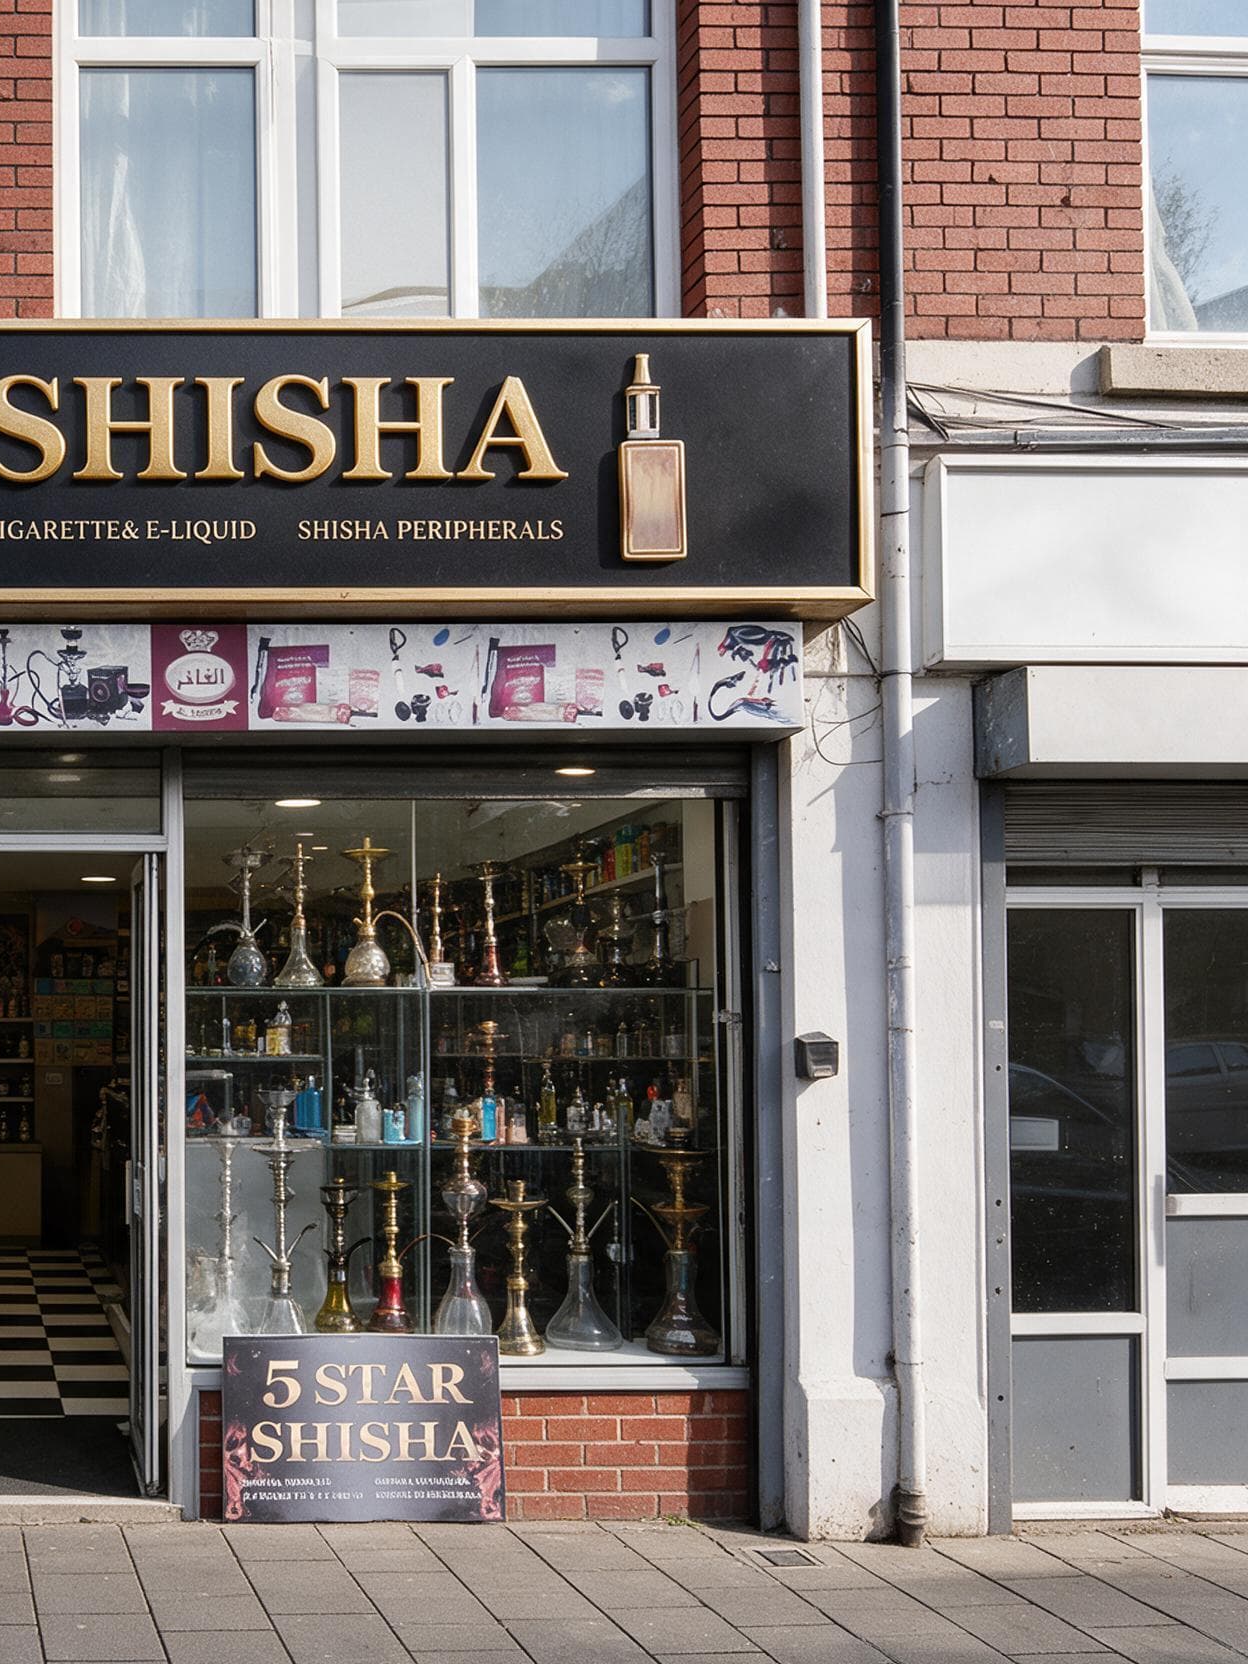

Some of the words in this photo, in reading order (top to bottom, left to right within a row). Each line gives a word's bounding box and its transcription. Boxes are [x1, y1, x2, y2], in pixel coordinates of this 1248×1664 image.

[146, 520, 257, 545] E-LIQUID
[297, 520, 390, 541] SHISHA
[397, 520, 564, 541] PERIPHERALS
[262, 1359, 302, 1409] 5
[314, 1362, 474, 1405] STAR
[250, 1420, 486, 1463] SHISHA
